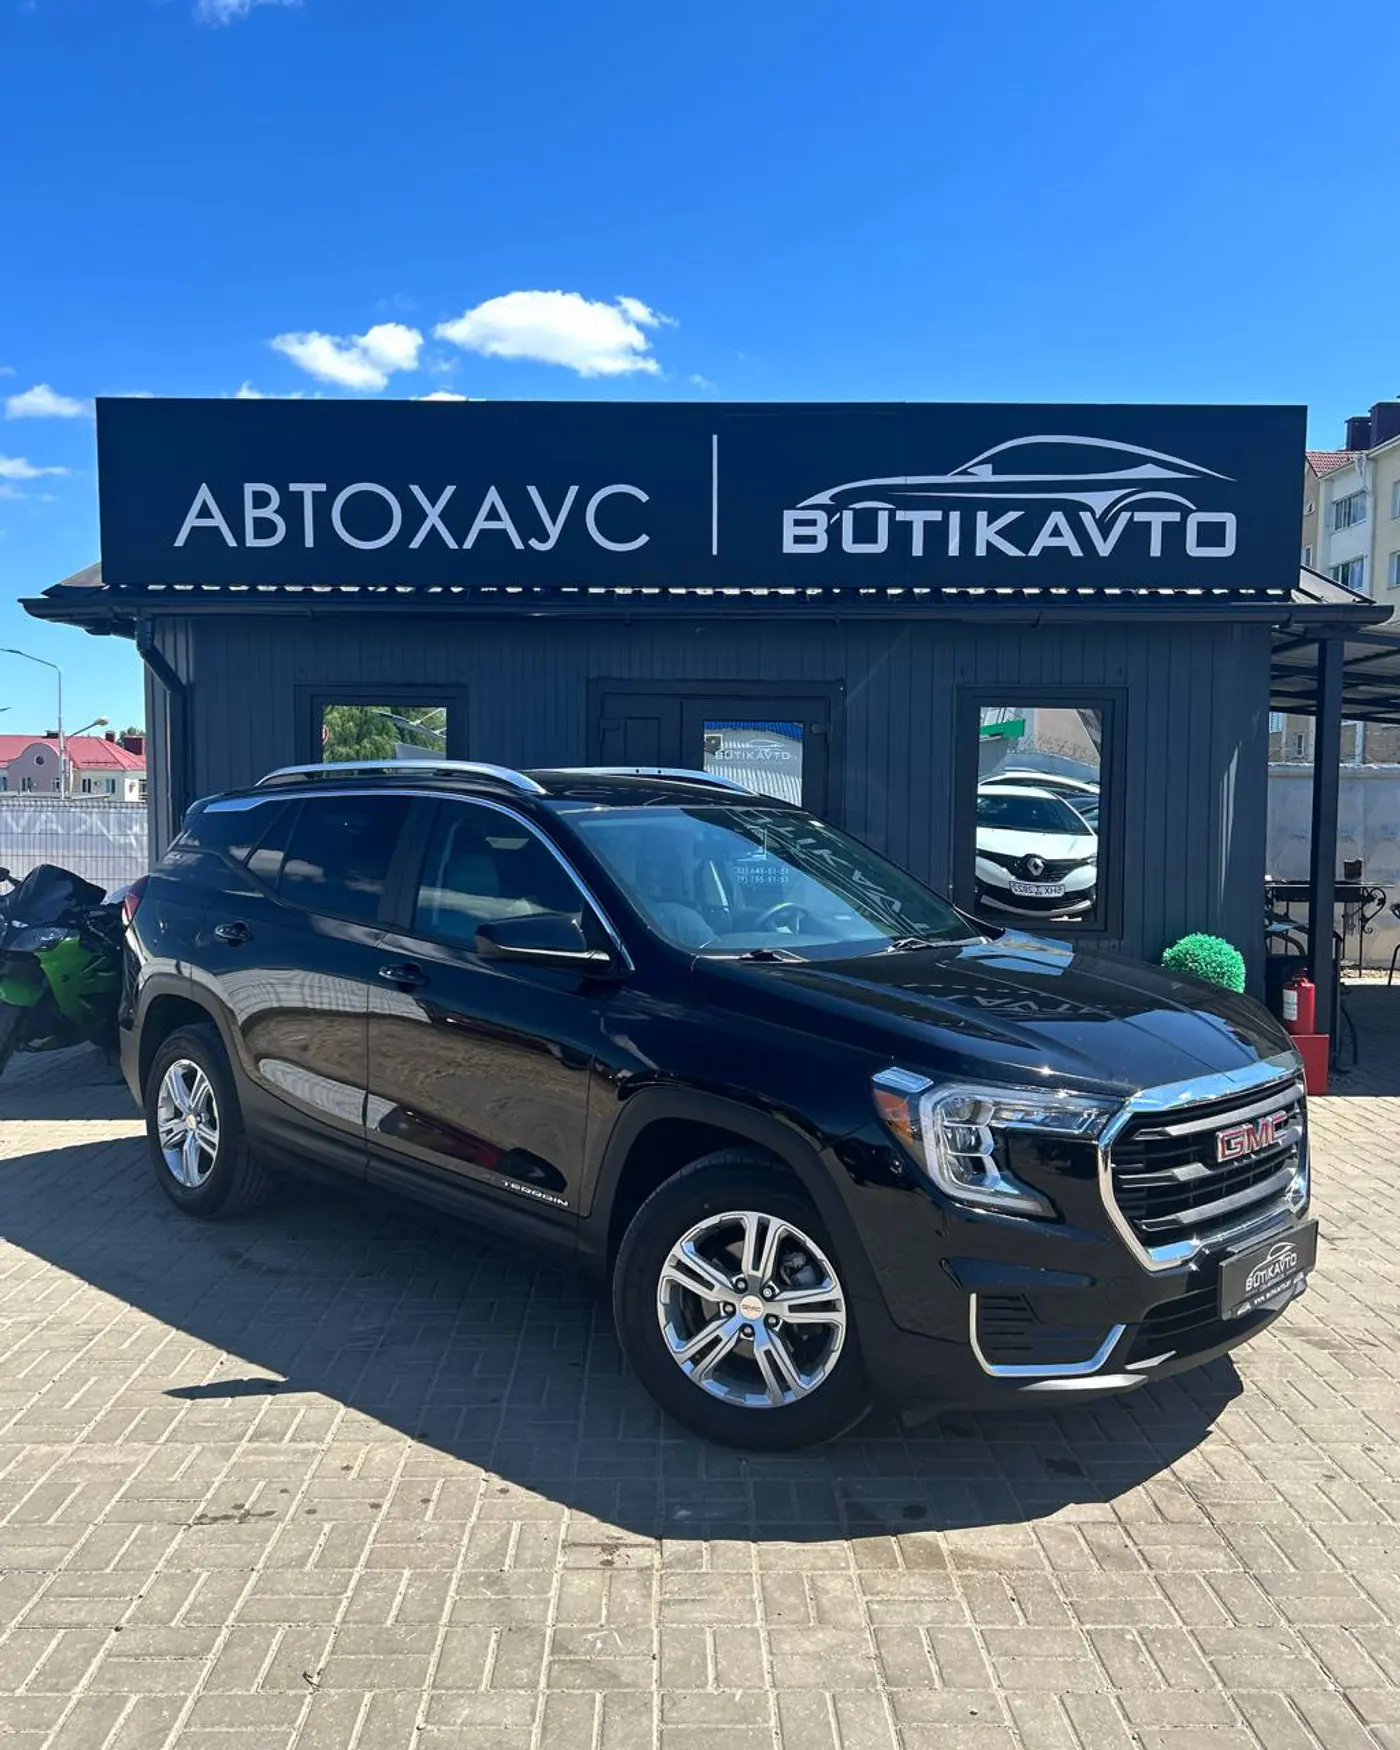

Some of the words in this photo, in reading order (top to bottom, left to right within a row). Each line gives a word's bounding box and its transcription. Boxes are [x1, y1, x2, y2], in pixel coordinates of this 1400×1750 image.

[173, 481, 652, 553] АВТОХАУС
[782, 509, 1238, 558] BUTIKAVTO
[715, 751, 791, 761] BUTIKAVTO
[1216, 1110, 1287, 1162] GMC
[1245, 1252, 1298, 1292] BUTIKAVTO
